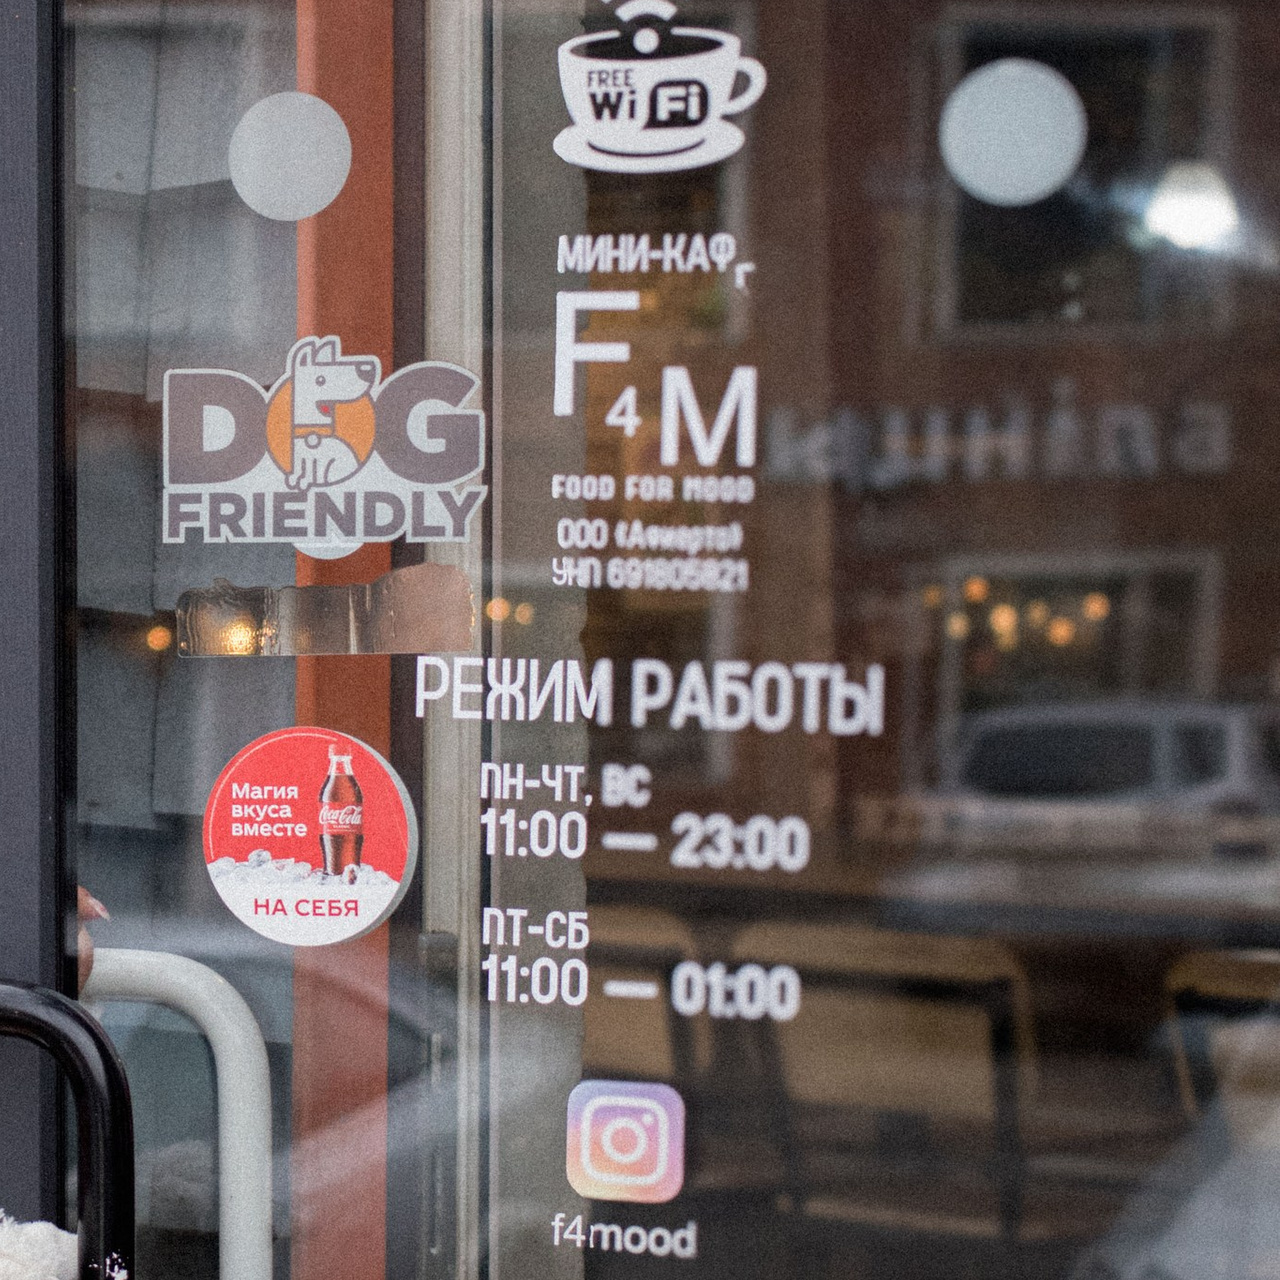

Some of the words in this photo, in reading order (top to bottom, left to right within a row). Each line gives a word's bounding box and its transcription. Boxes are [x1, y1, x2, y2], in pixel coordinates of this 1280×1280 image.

[587, 69, 634, 88] FREE
[167, 365, 481, 486] DOG
[551, 474, 616, 500] FOOD
[624, 475, 674, 501] FOR
[682, 475, 756, 504] MOOD
[167, 490, 482, 539] FRIENDLY
[557, 518, 609, 549] ООО
[552, 556, 602, 588] УНП
[415, 656, 615, 727] РЕЖИМ
[630, 658, 886, 736] РАБОТЫ
[231, 783, 299, 800] Магия
[480, 762, 593, 807] ПН-ЧТ,
[600, 763, 653, 808] ВС
[231, 804, 292, 821] вкуса
[231, 823, 308, 837] вместе
[480, 808, 588, 859] 11:00
[670, 811, 811, 872] 23:00
[253, 898, 288, 917] НА
[294, 898, 360, 918] СЕБЯ
[482, 907, 590, 950] ПТ-СБ
[481, 954, 589, 1007] 11:00
[671, 960, 802, 1022] 01:00
[550, 1212, 699, 1259] f4mood
